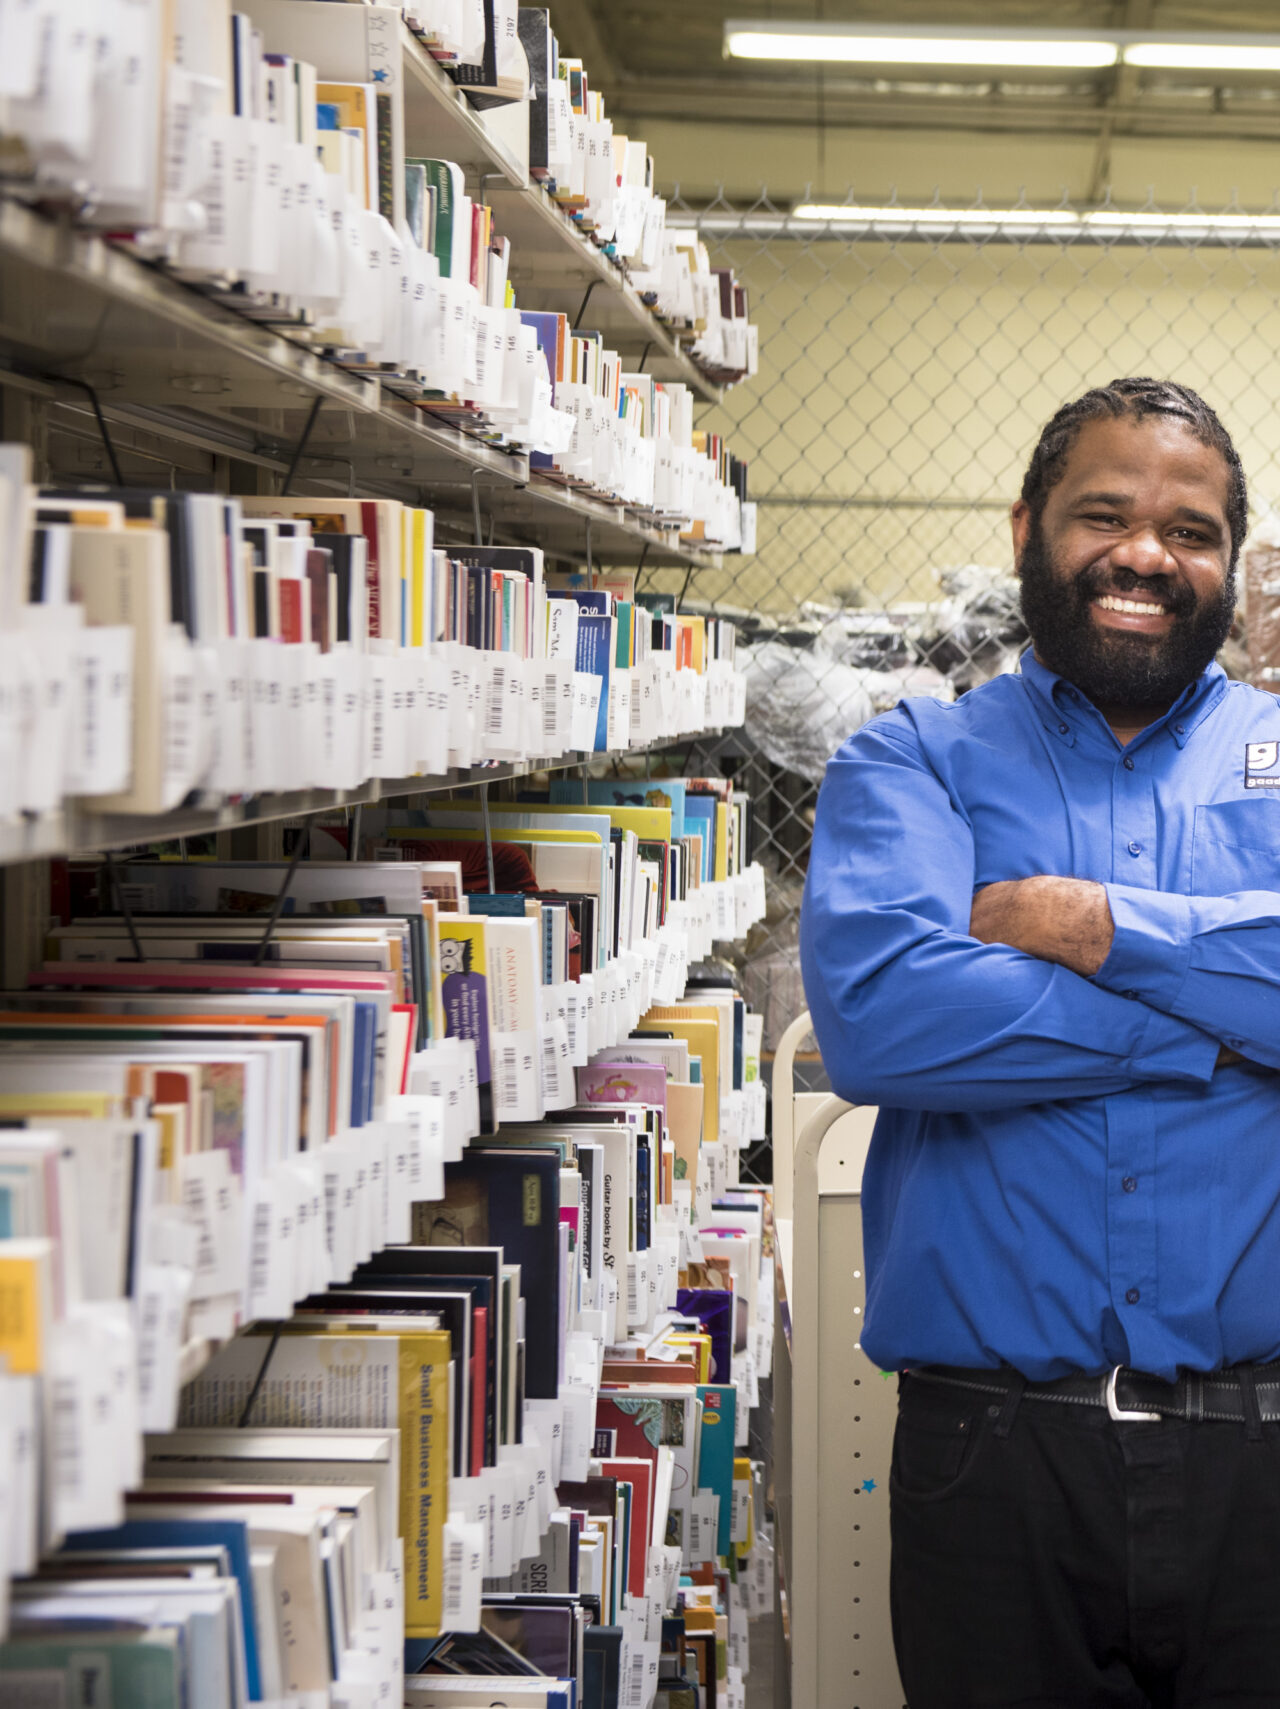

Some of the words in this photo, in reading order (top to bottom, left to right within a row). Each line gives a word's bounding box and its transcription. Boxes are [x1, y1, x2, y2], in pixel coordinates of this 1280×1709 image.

[506, 17, 514, 37] 2197
[532, 687, 540, 701] 131
[563, 684, 571, 698] 134
[580, 693, 588, 706] 107
[507, 947, 519, 1004] ANATOMY
[461, 992, 469, 1005] find
[461, 1006, 471, 1025] every
[604, 1174, 612, 1205] Guitar
[604, 1207, 612, 1235] books
[603, 1237, 612, 1249] by
[419, 1364, 434, 1409] Small
[419, 1414, 433, 1488] Business
[416, 1494, 433, 1601] Management
[649, 1663, 657, 1675] 128
